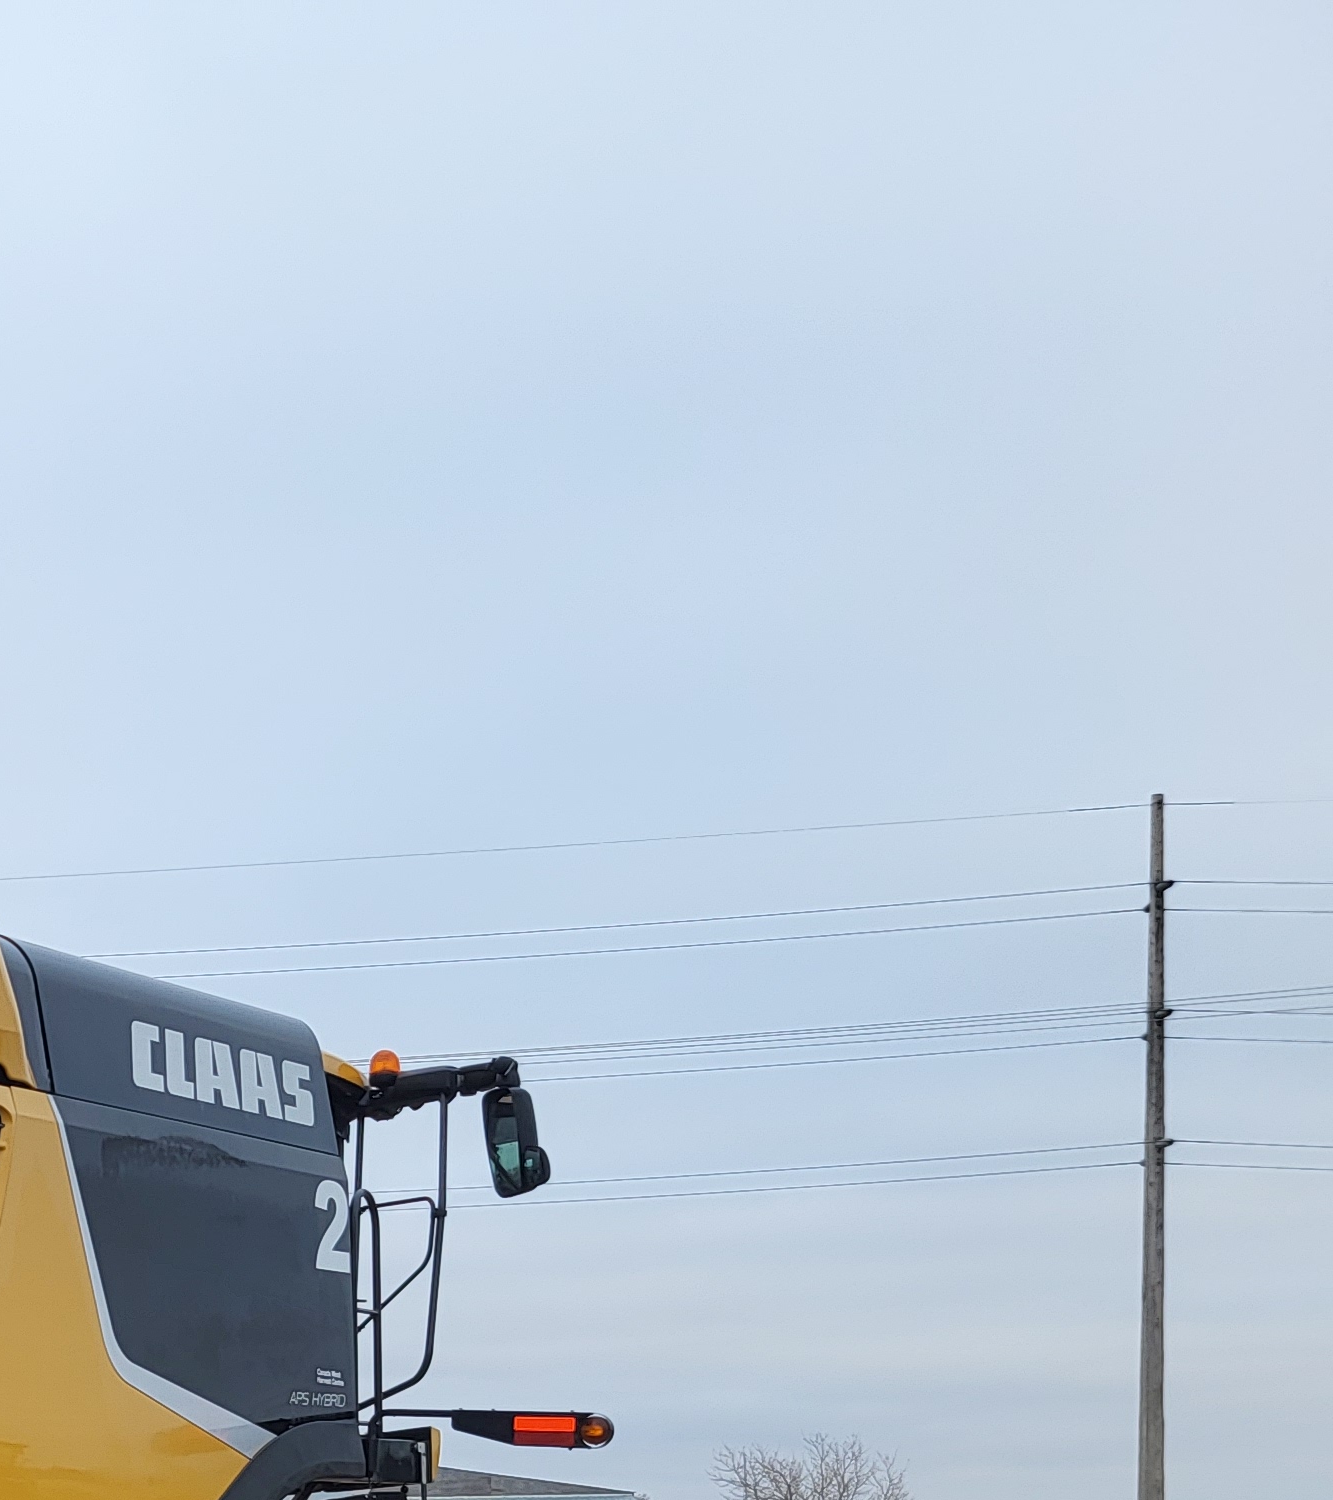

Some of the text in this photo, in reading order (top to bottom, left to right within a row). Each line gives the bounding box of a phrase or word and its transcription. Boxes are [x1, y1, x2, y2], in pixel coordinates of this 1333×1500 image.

[130, 1020, 315, 1127] CLAAS
[314, 1179, 351, 1274] 2
[289, 1391, 310, 1406] APS
